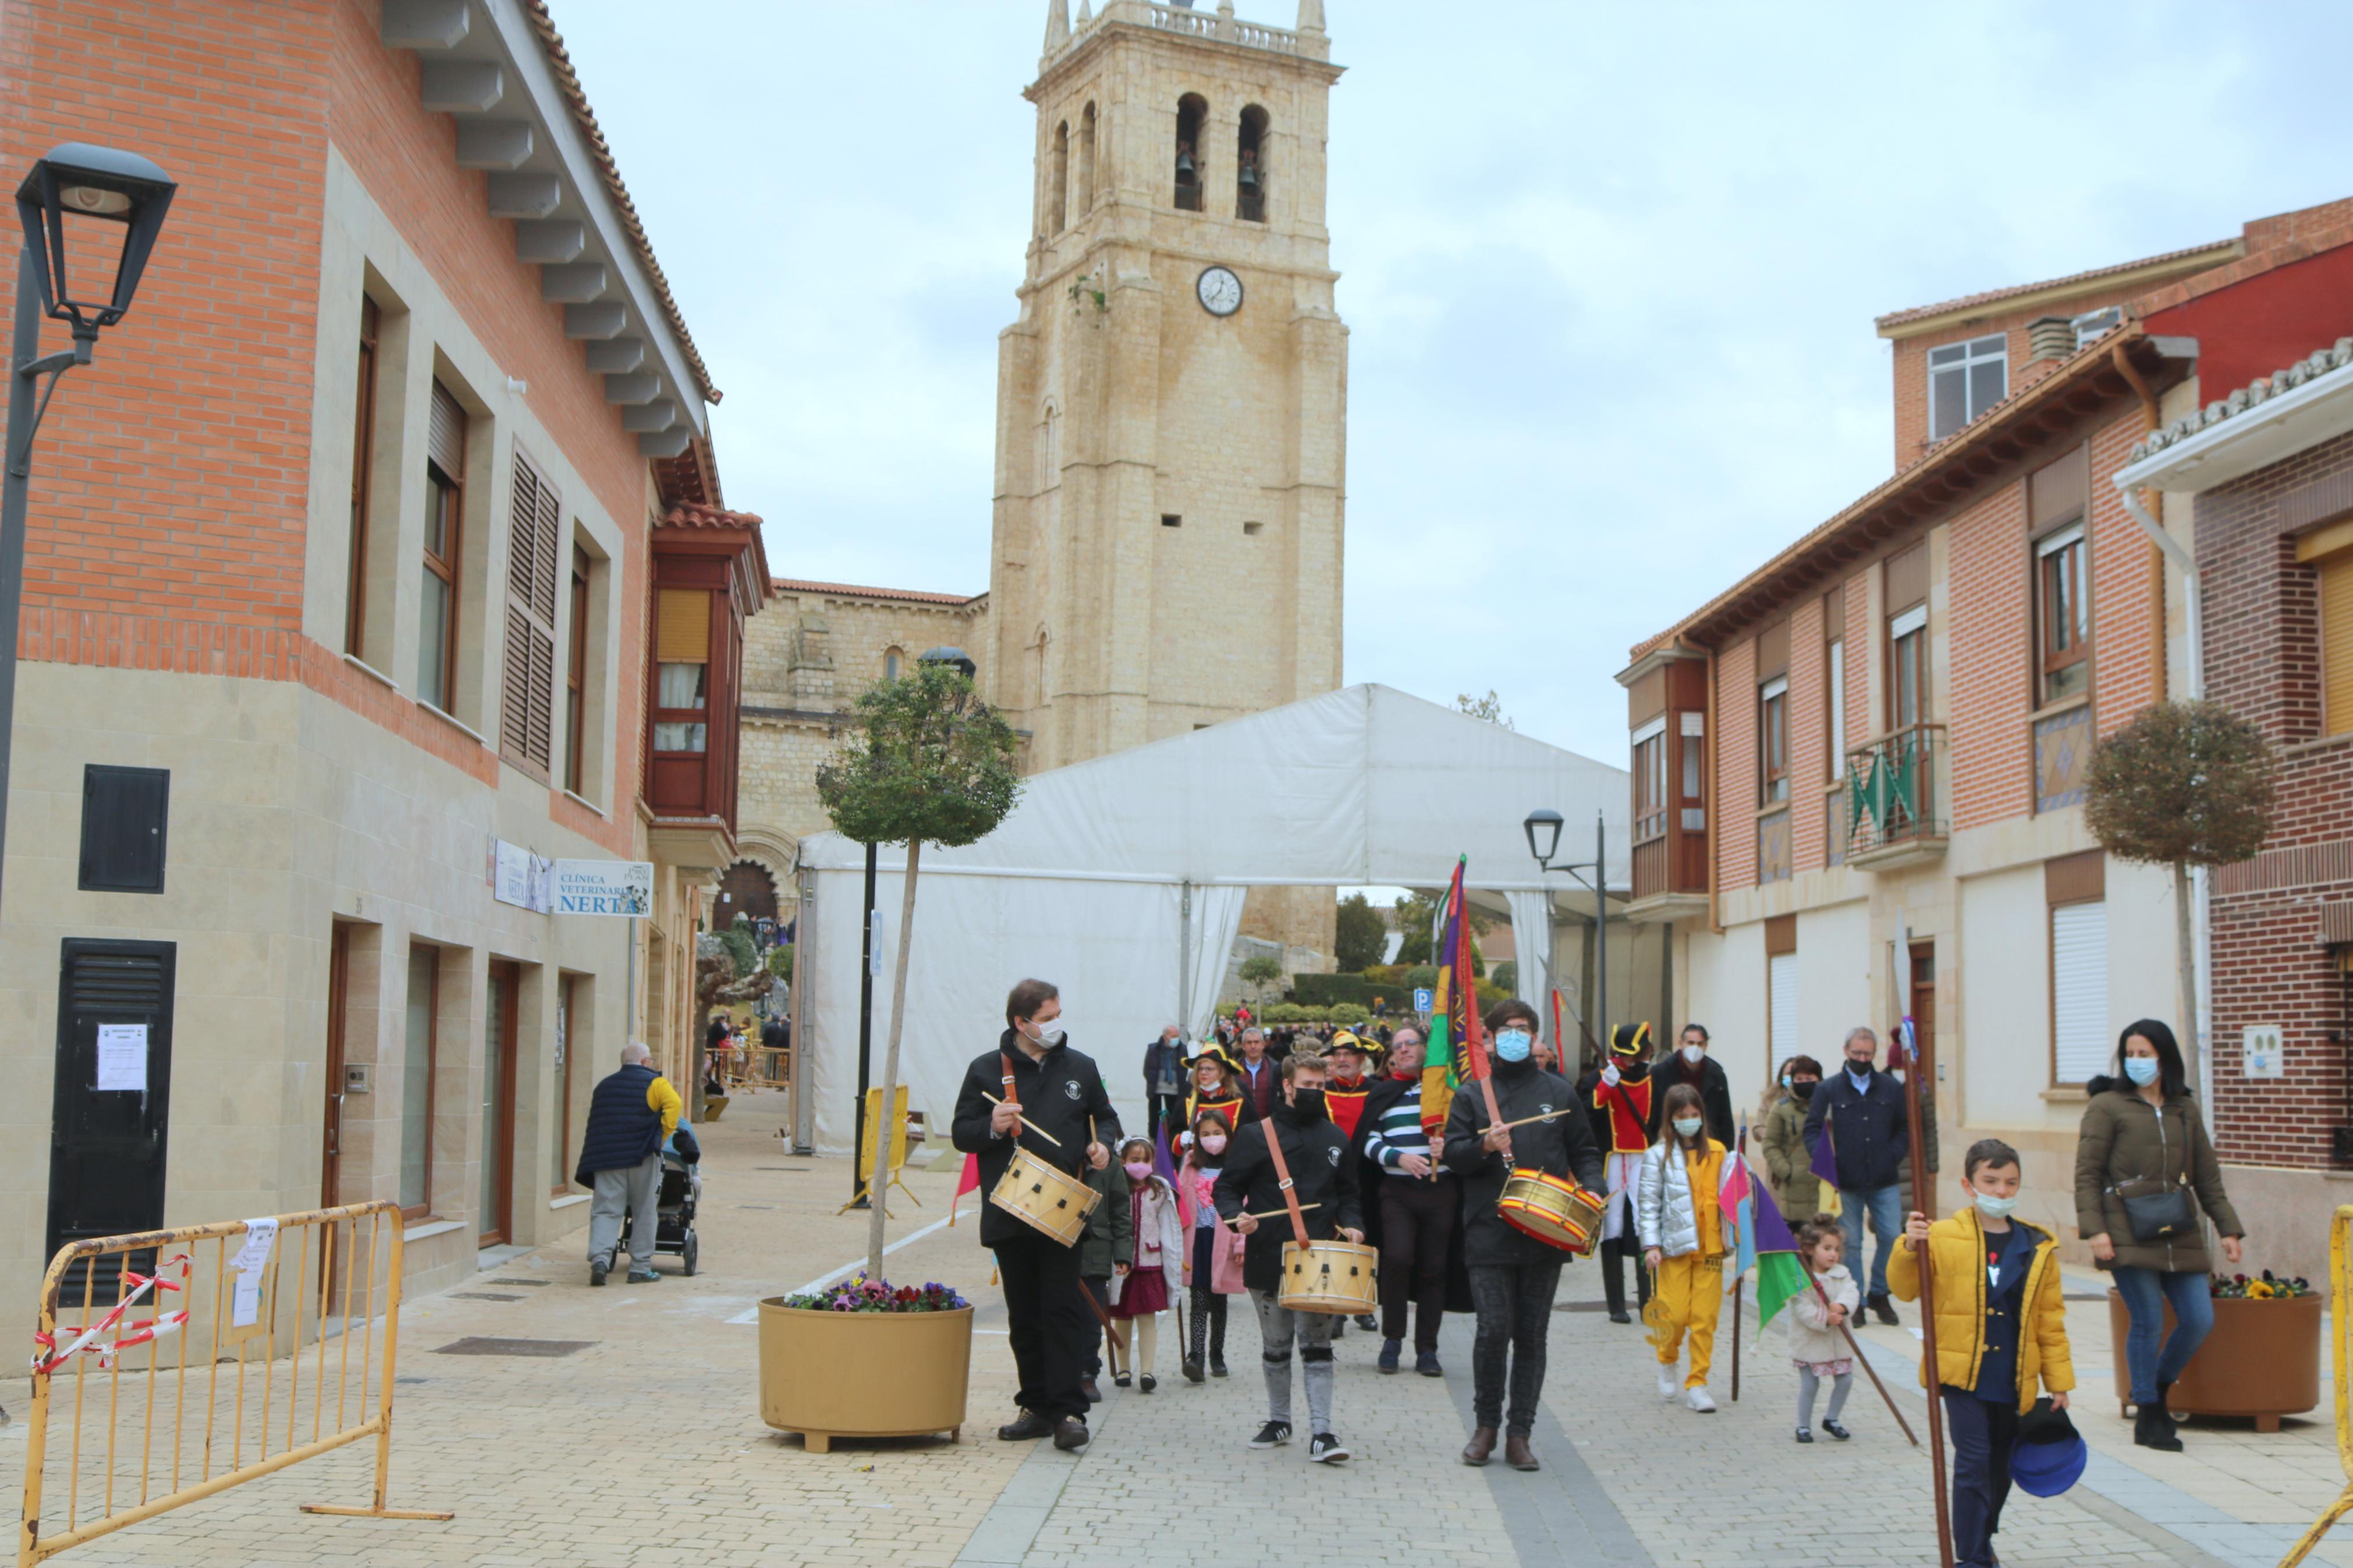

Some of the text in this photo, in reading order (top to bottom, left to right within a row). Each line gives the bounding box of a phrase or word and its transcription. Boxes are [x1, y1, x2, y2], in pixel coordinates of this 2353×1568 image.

[560, 873, 605, 884] CLÍNICA
[559, 895, 637, 914] NERTA
[1418, 991, 1428, 1009] P
